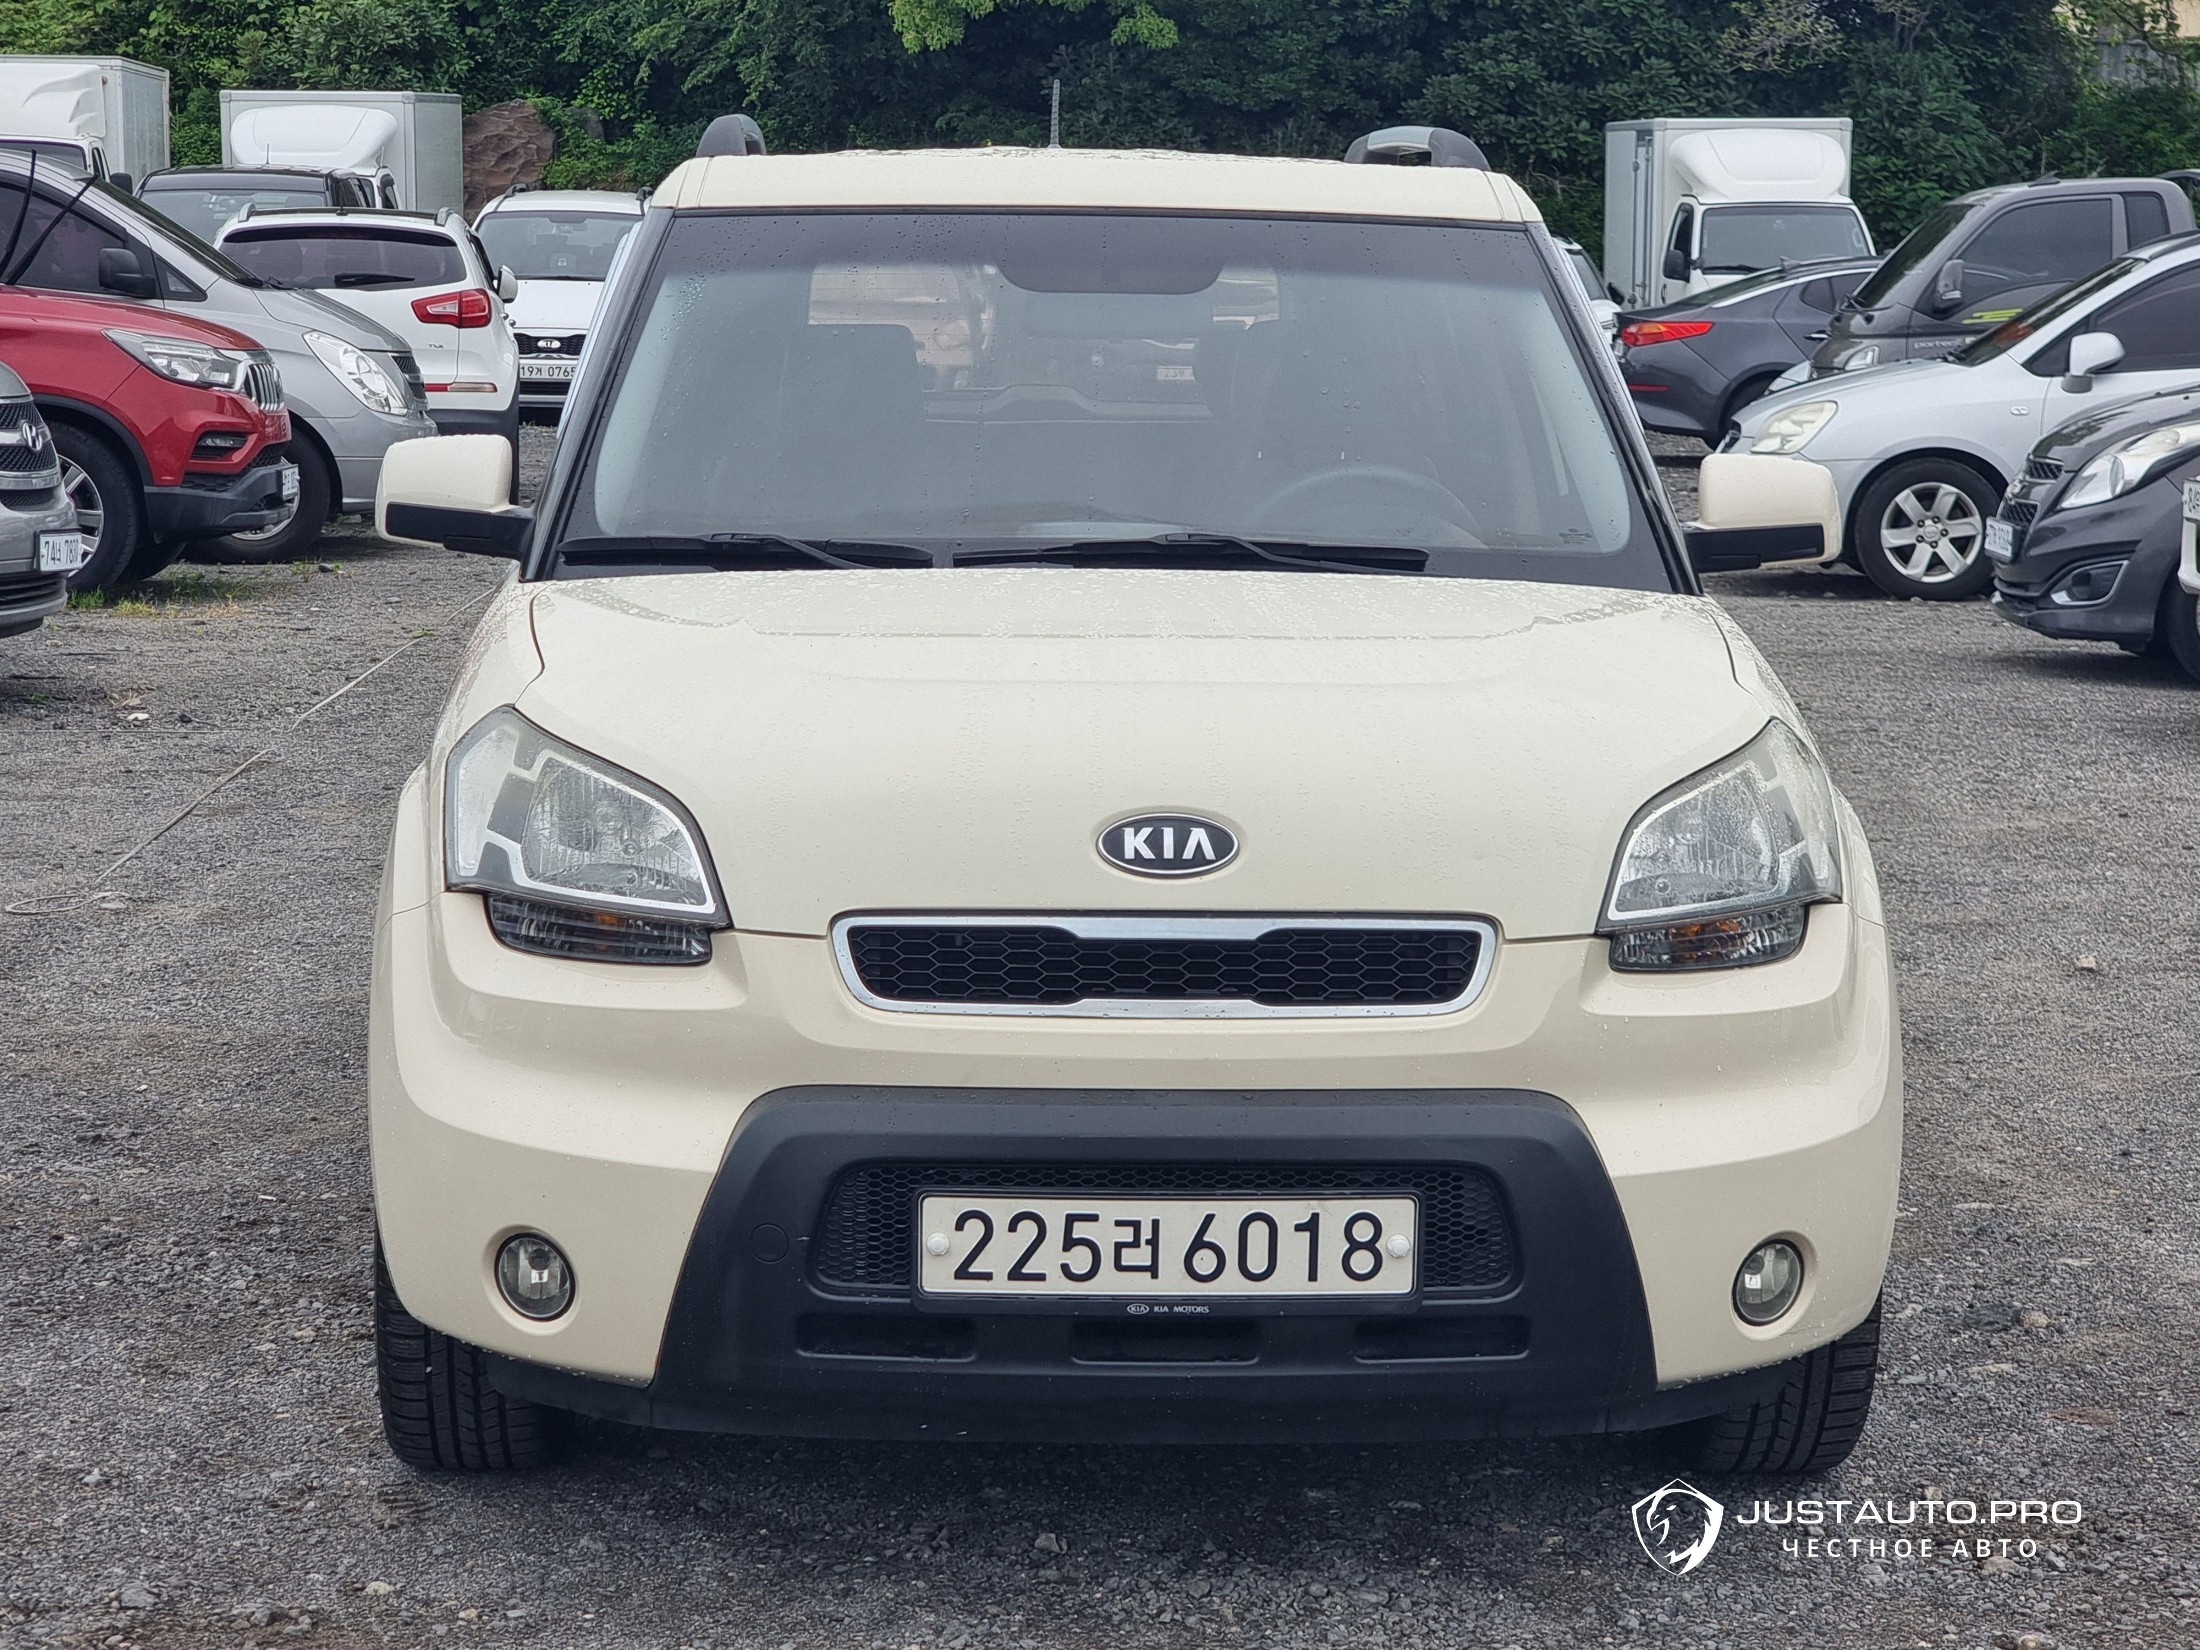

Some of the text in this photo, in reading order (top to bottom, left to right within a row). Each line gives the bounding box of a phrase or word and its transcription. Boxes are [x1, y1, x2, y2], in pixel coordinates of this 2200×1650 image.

[1122, 827, 1217, 860] KIA
[953, 1209, 1384, 1283] 225러 6018
[1153, 1305, 1210, 1314] KIA MOTORS
